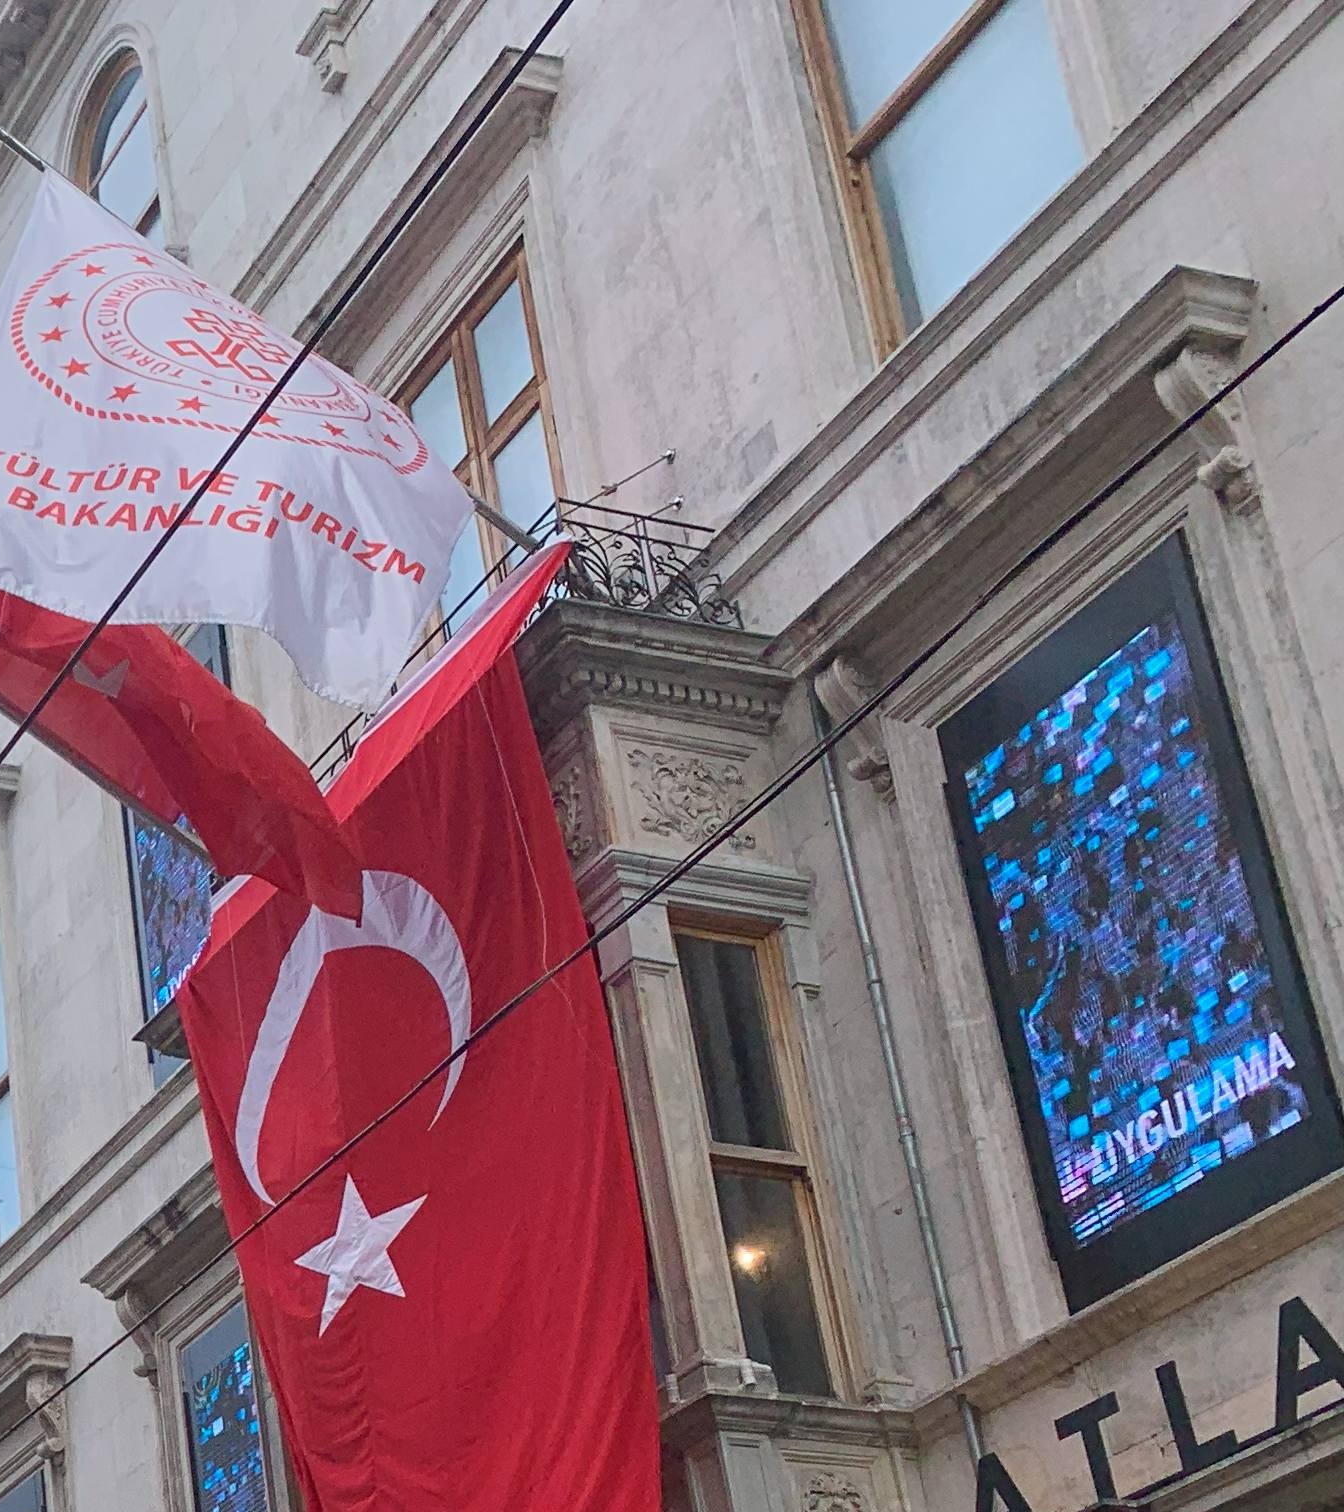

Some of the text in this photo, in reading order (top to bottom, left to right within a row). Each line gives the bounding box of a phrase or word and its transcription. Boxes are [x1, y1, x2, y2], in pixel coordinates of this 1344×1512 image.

[8, 487, 279, 540] BAKANLIĞI
[178, 466, 239, 496] VE
[256, 480, 426, 584] TURİZM
[1091, 1031, 1296, 1186] UYGULAMA
